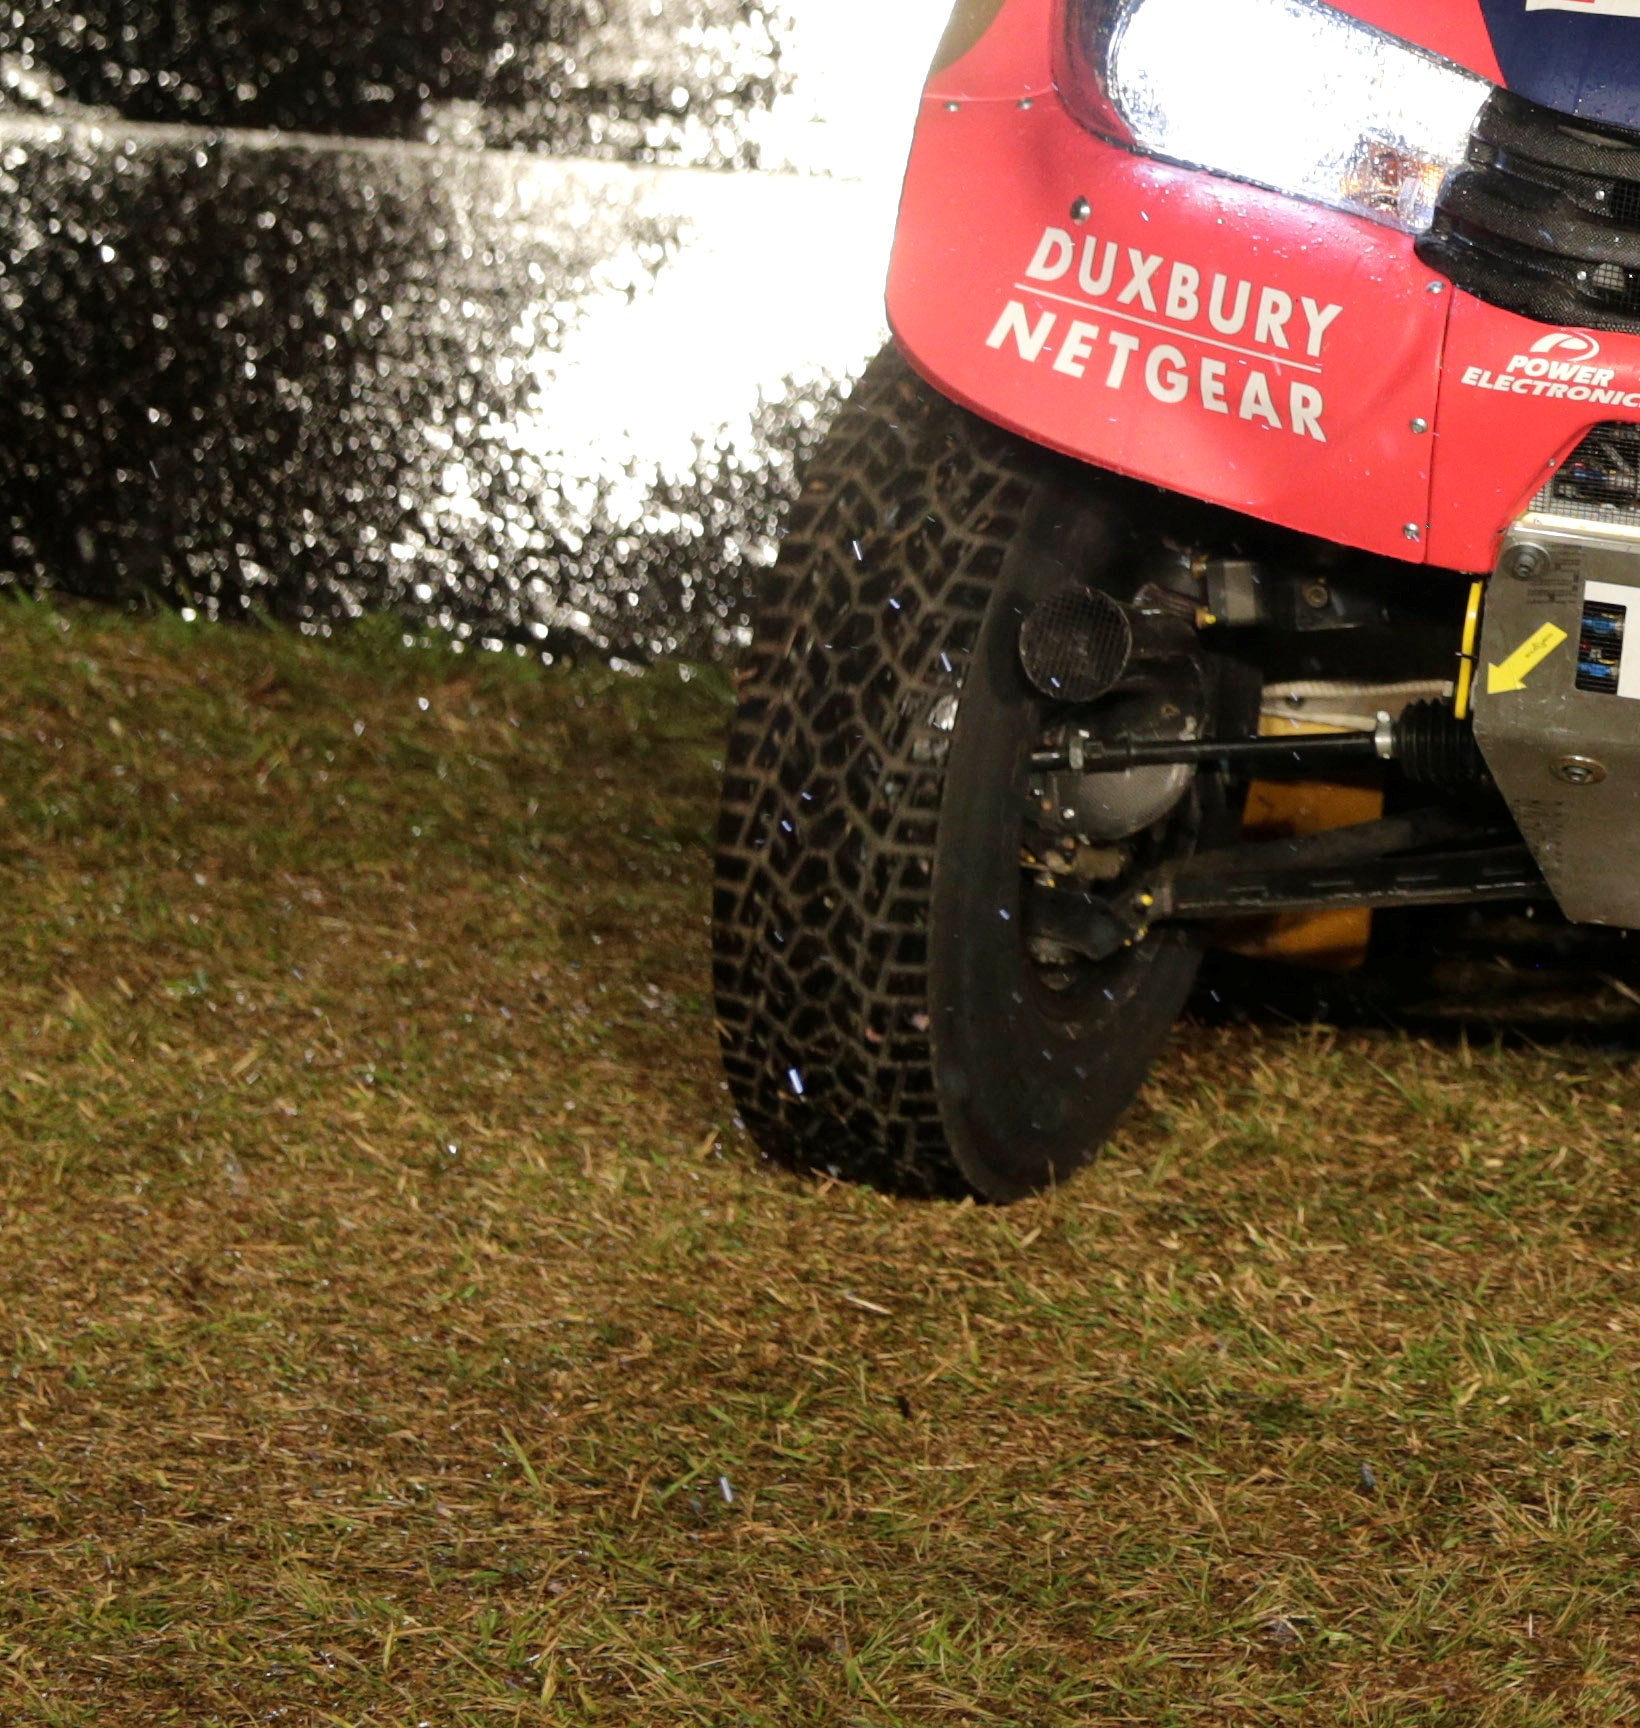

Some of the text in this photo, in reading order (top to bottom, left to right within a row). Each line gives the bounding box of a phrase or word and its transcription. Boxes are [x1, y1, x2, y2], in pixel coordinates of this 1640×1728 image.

[1025, 226, 1343, 358] DUXBURY
[985, 301, 1328, 443] NETGEAR
[1507, 353, 1615, 387] POWER
